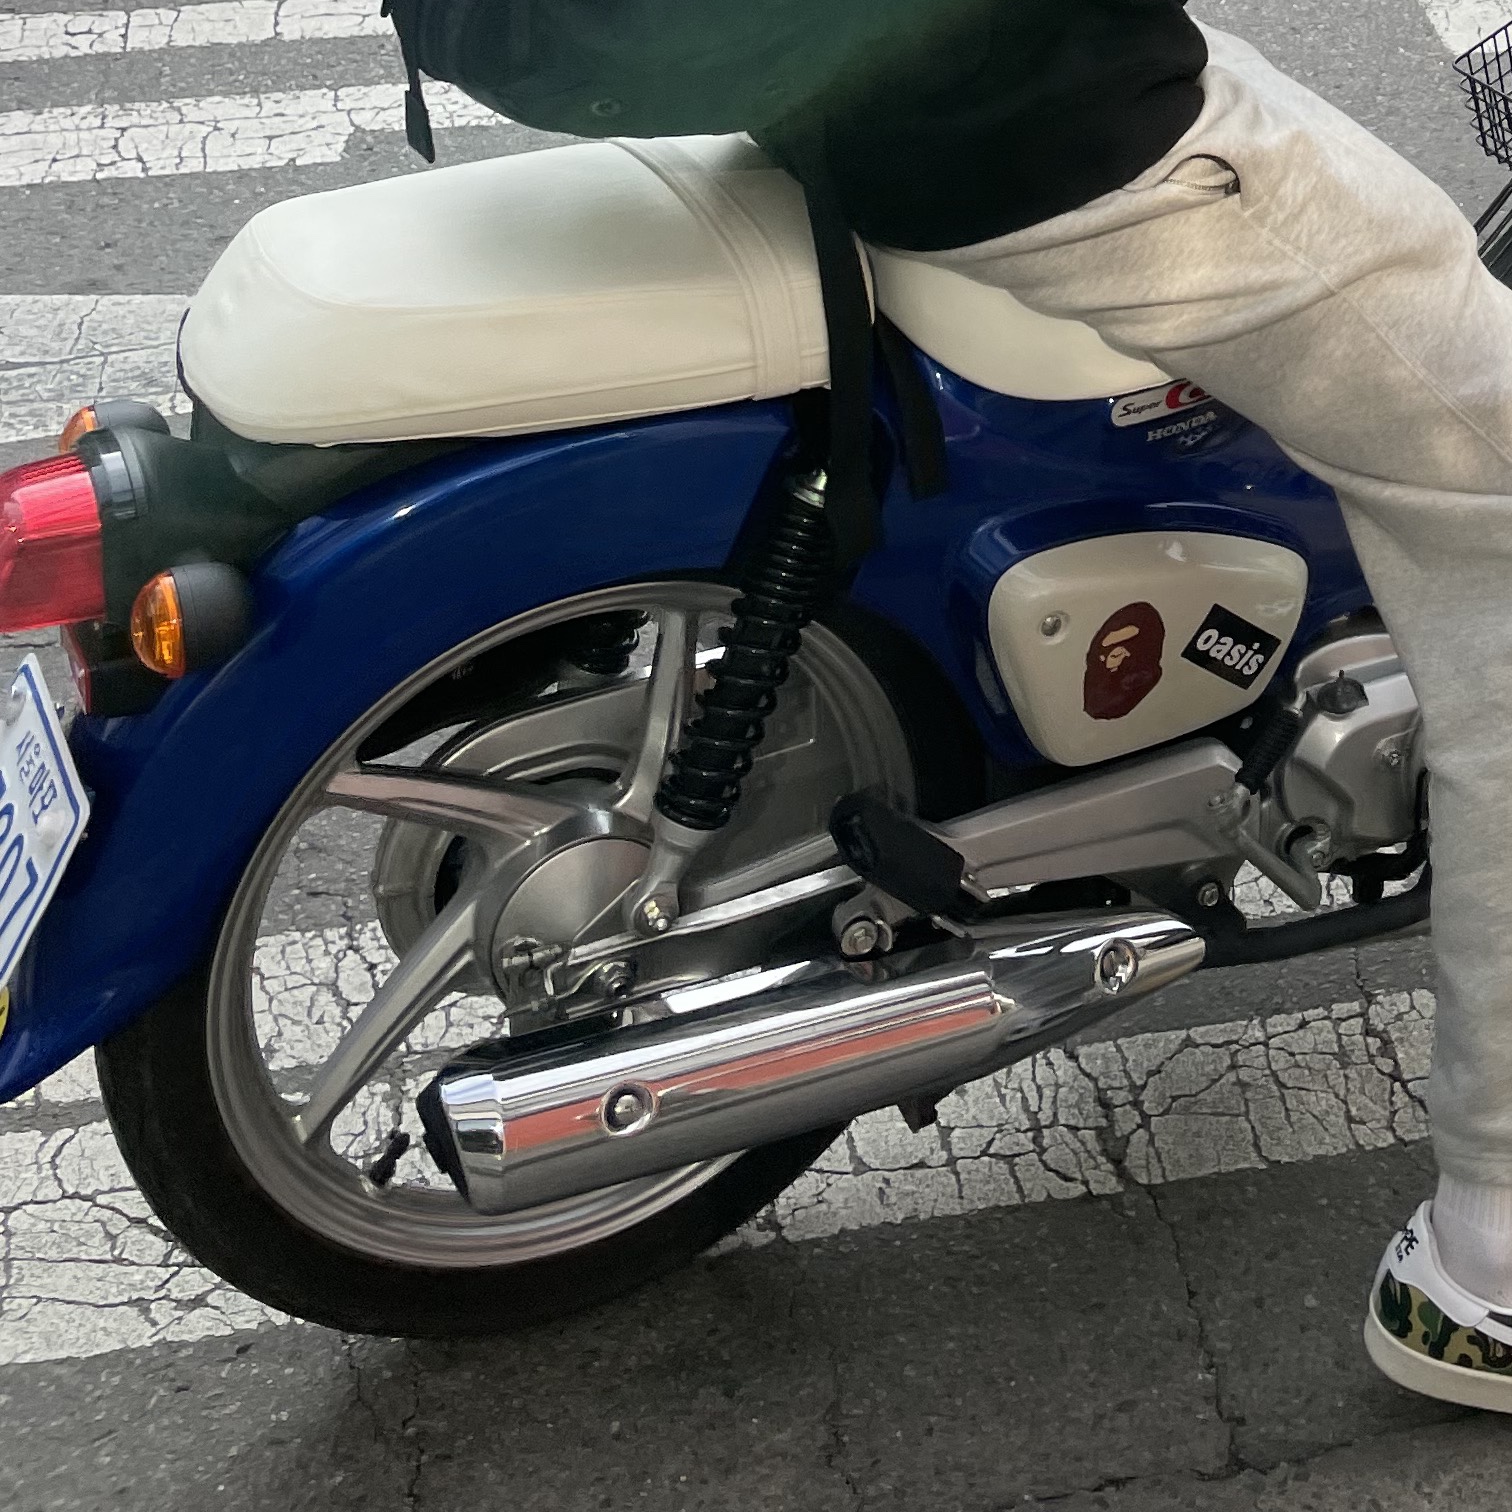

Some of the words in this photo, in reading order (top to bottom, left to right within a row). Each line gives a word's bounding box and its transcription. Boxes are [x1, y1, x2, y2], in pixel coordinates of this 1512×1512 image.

[1118, 400, 1163, 419] Super
[1146, 411, 1218, 442] HONDA
[1196, 628, 1265, 676] oasis
